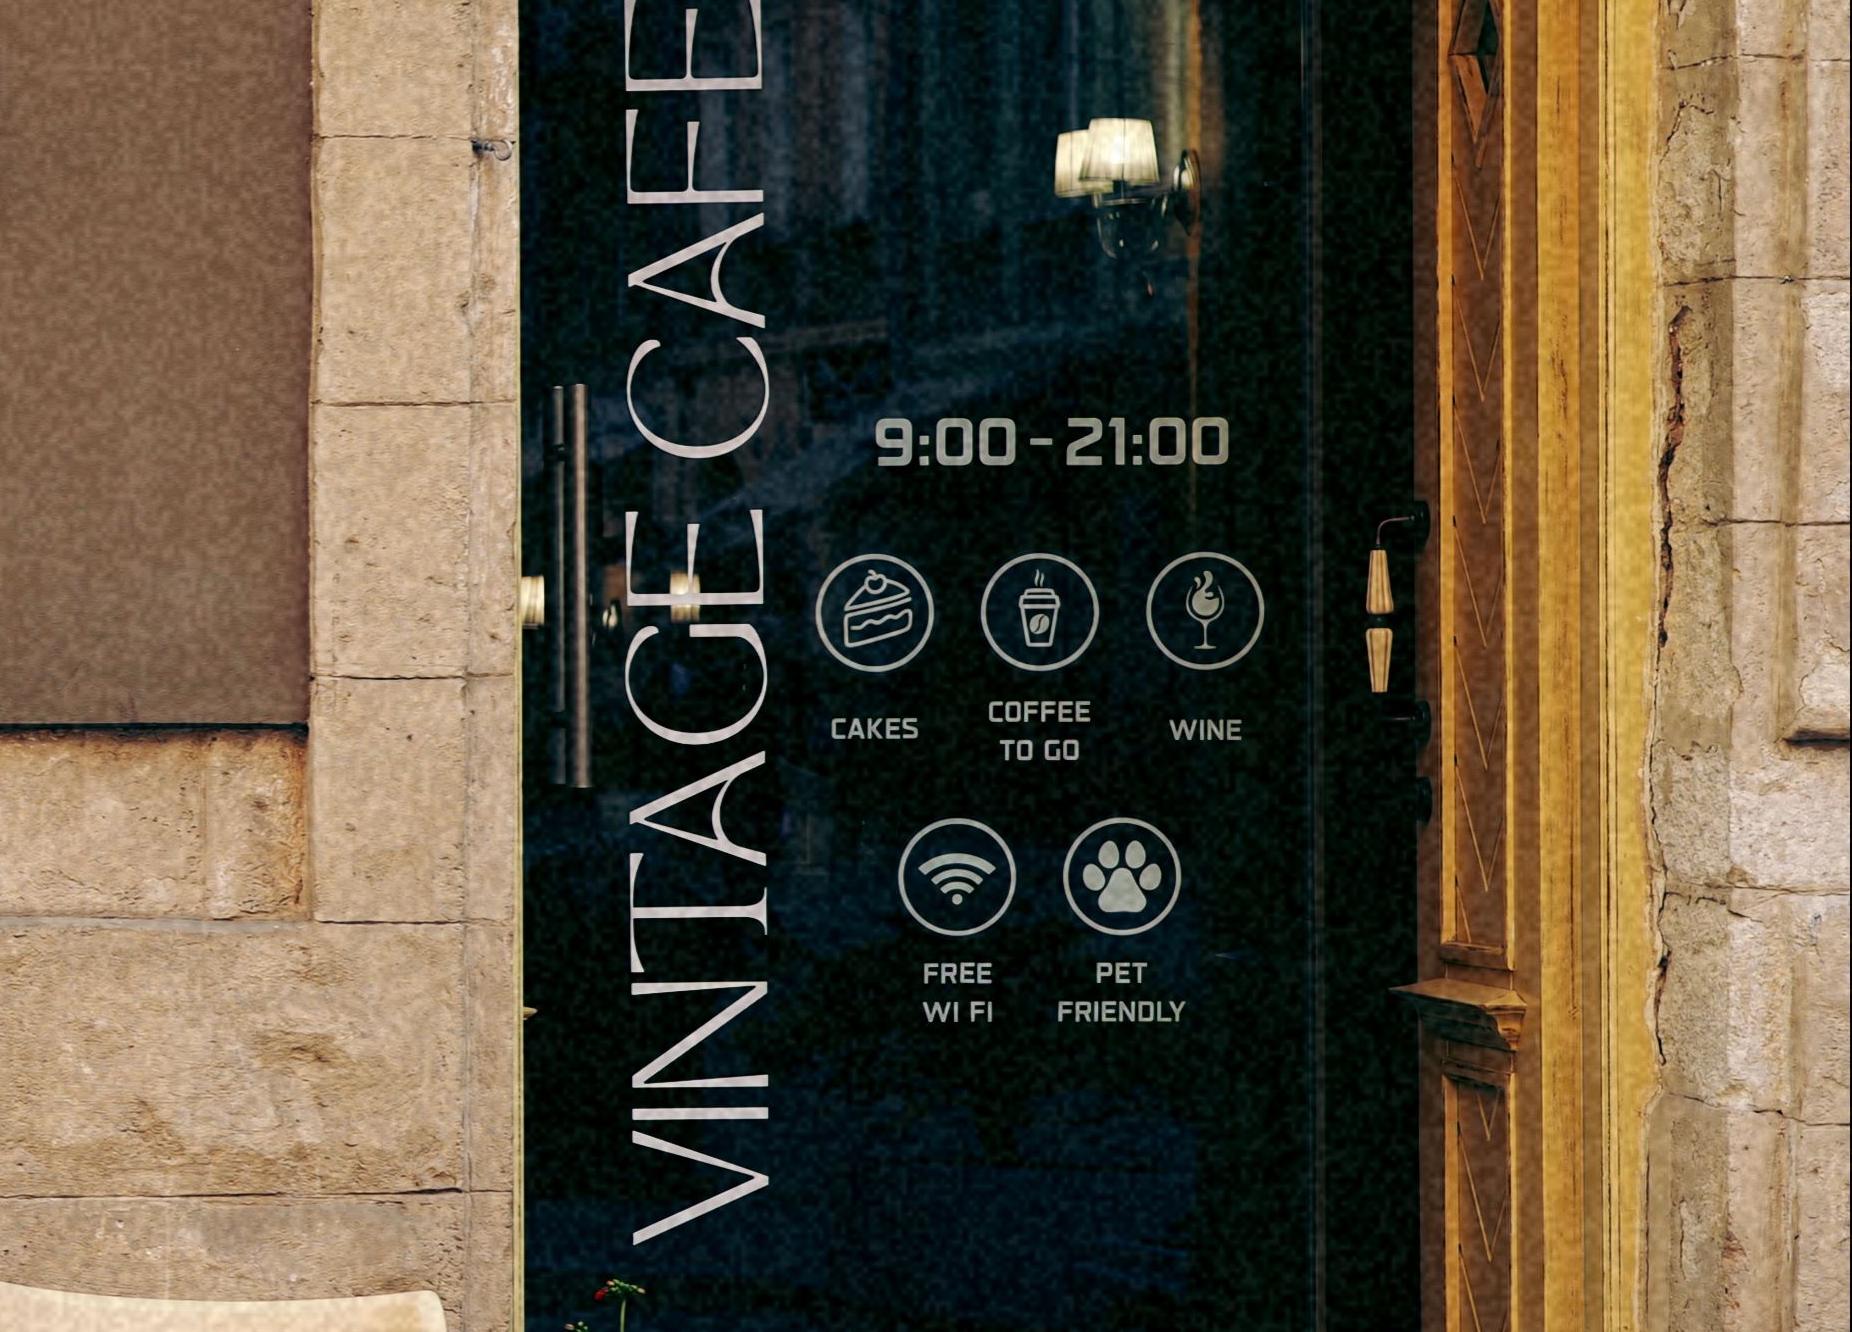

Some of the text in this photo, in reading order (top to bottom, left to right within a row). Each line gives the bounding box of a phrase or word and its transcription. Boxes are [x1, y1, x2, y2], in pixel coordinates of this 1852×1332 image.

[988, 700, 1092, 724] COFFEE
[830, 717, 919, 741] CAKES
[1169, 719, 1243, 742] WINE
[999, 739, 1080, 761] TO GO
[624, 509, 769, 1246] VINTAGE
[923, 962, 993, 984] FREE
[1096, 962, 1148, 984] PET
[922, 1001, 994, 1023] WI FI
[1057, 1000, 1187, 1023] FRIENDLY
